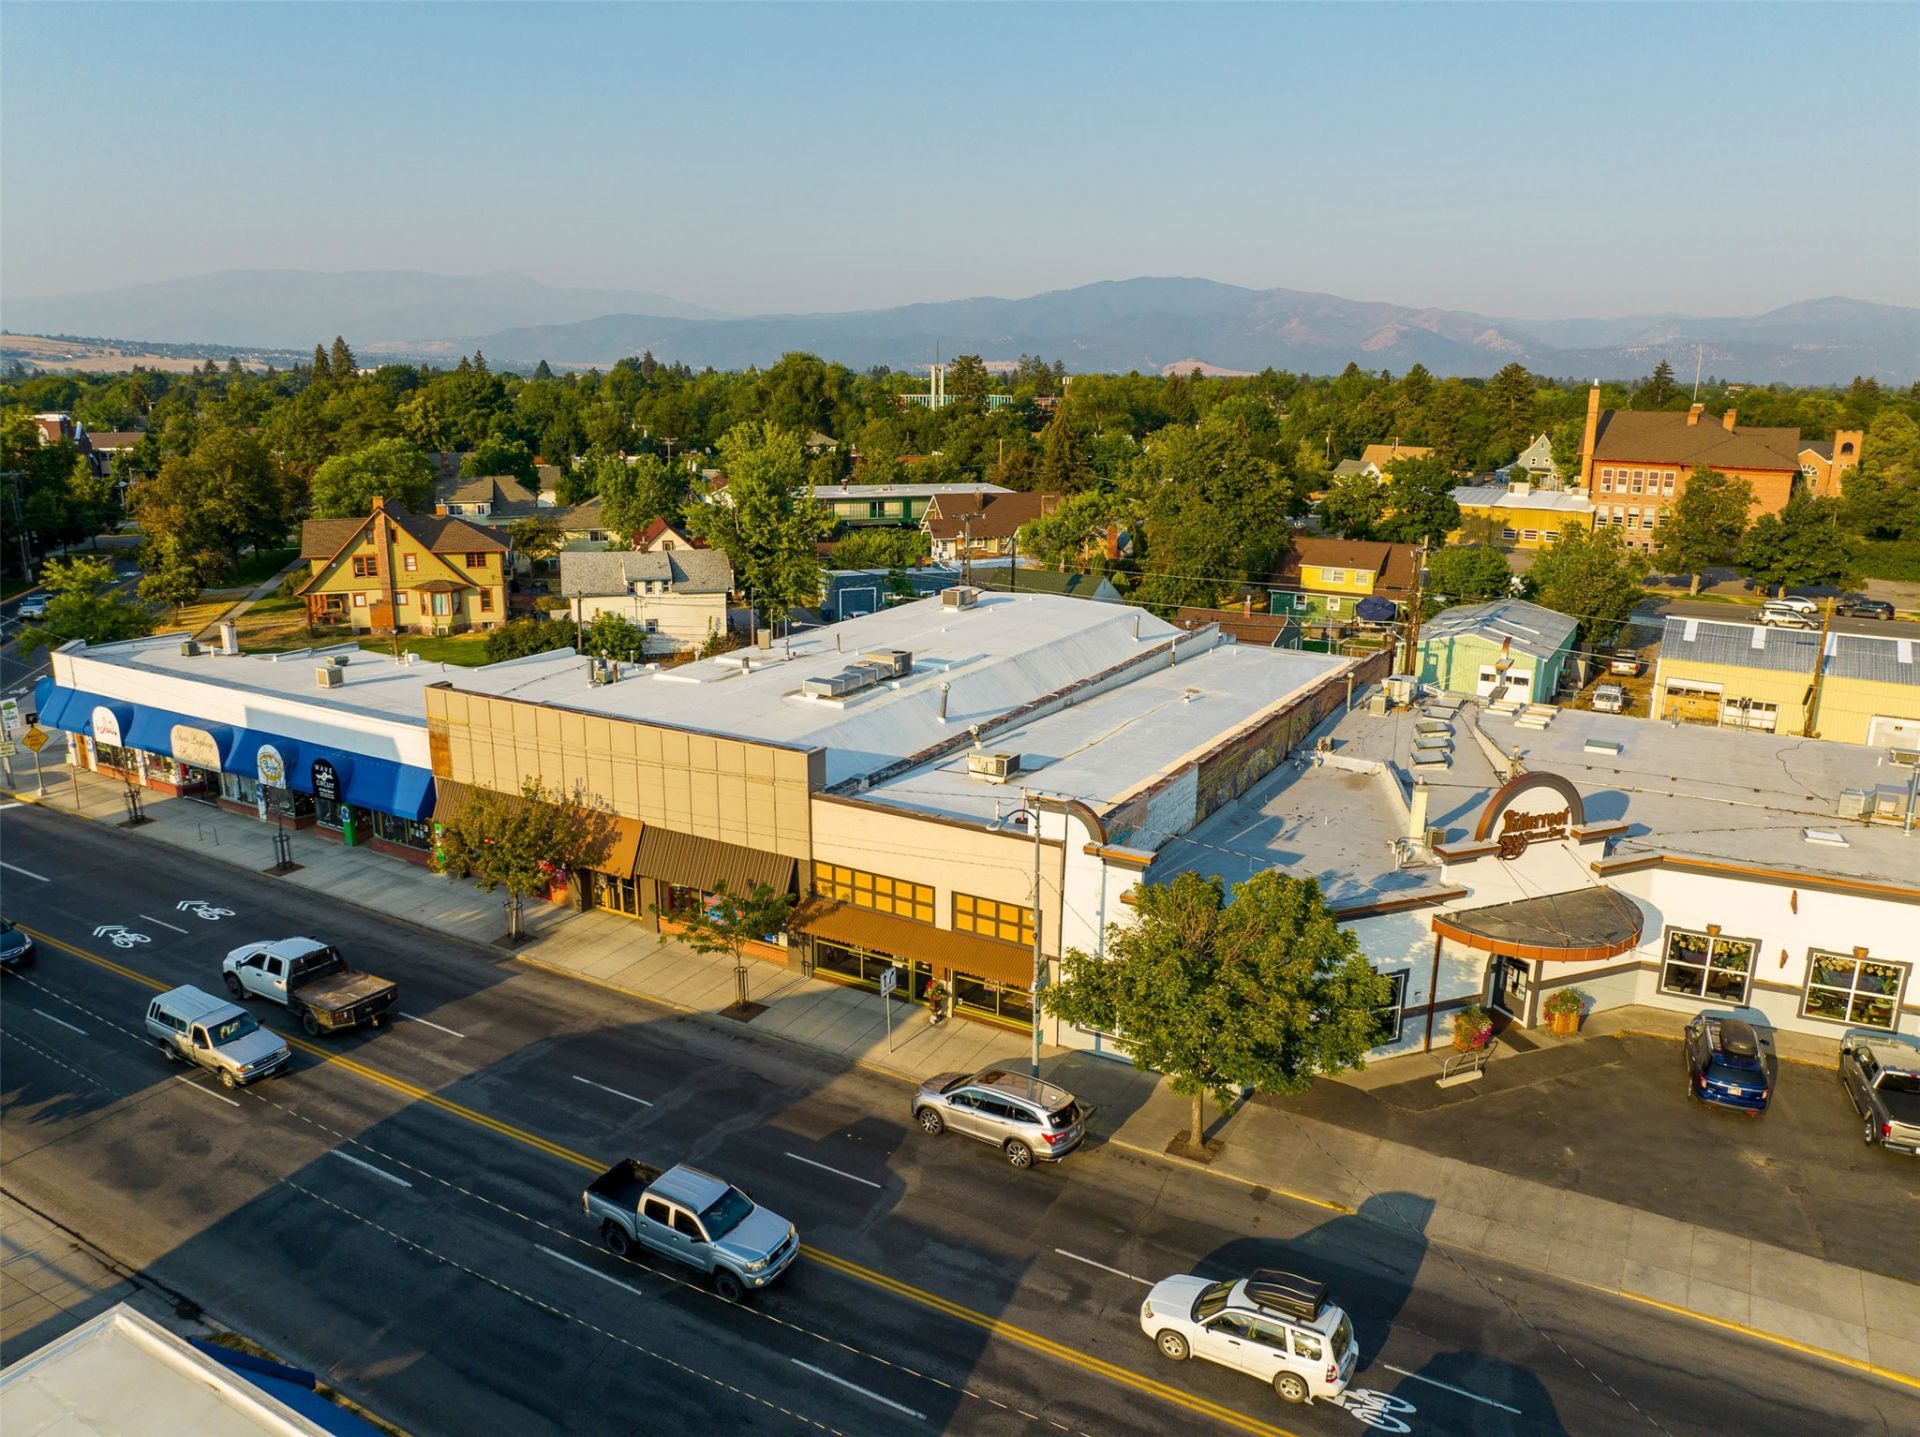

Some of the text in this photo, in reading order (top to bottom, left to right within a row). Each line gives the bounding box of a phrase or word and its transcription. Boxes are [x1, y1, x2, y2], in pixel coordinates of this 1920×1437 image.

[314, 764, 333, 774] WAVE
[316, 780, 335, 789] CIRCUIT
[1502, 806, 1570, 833] Bitterroot
